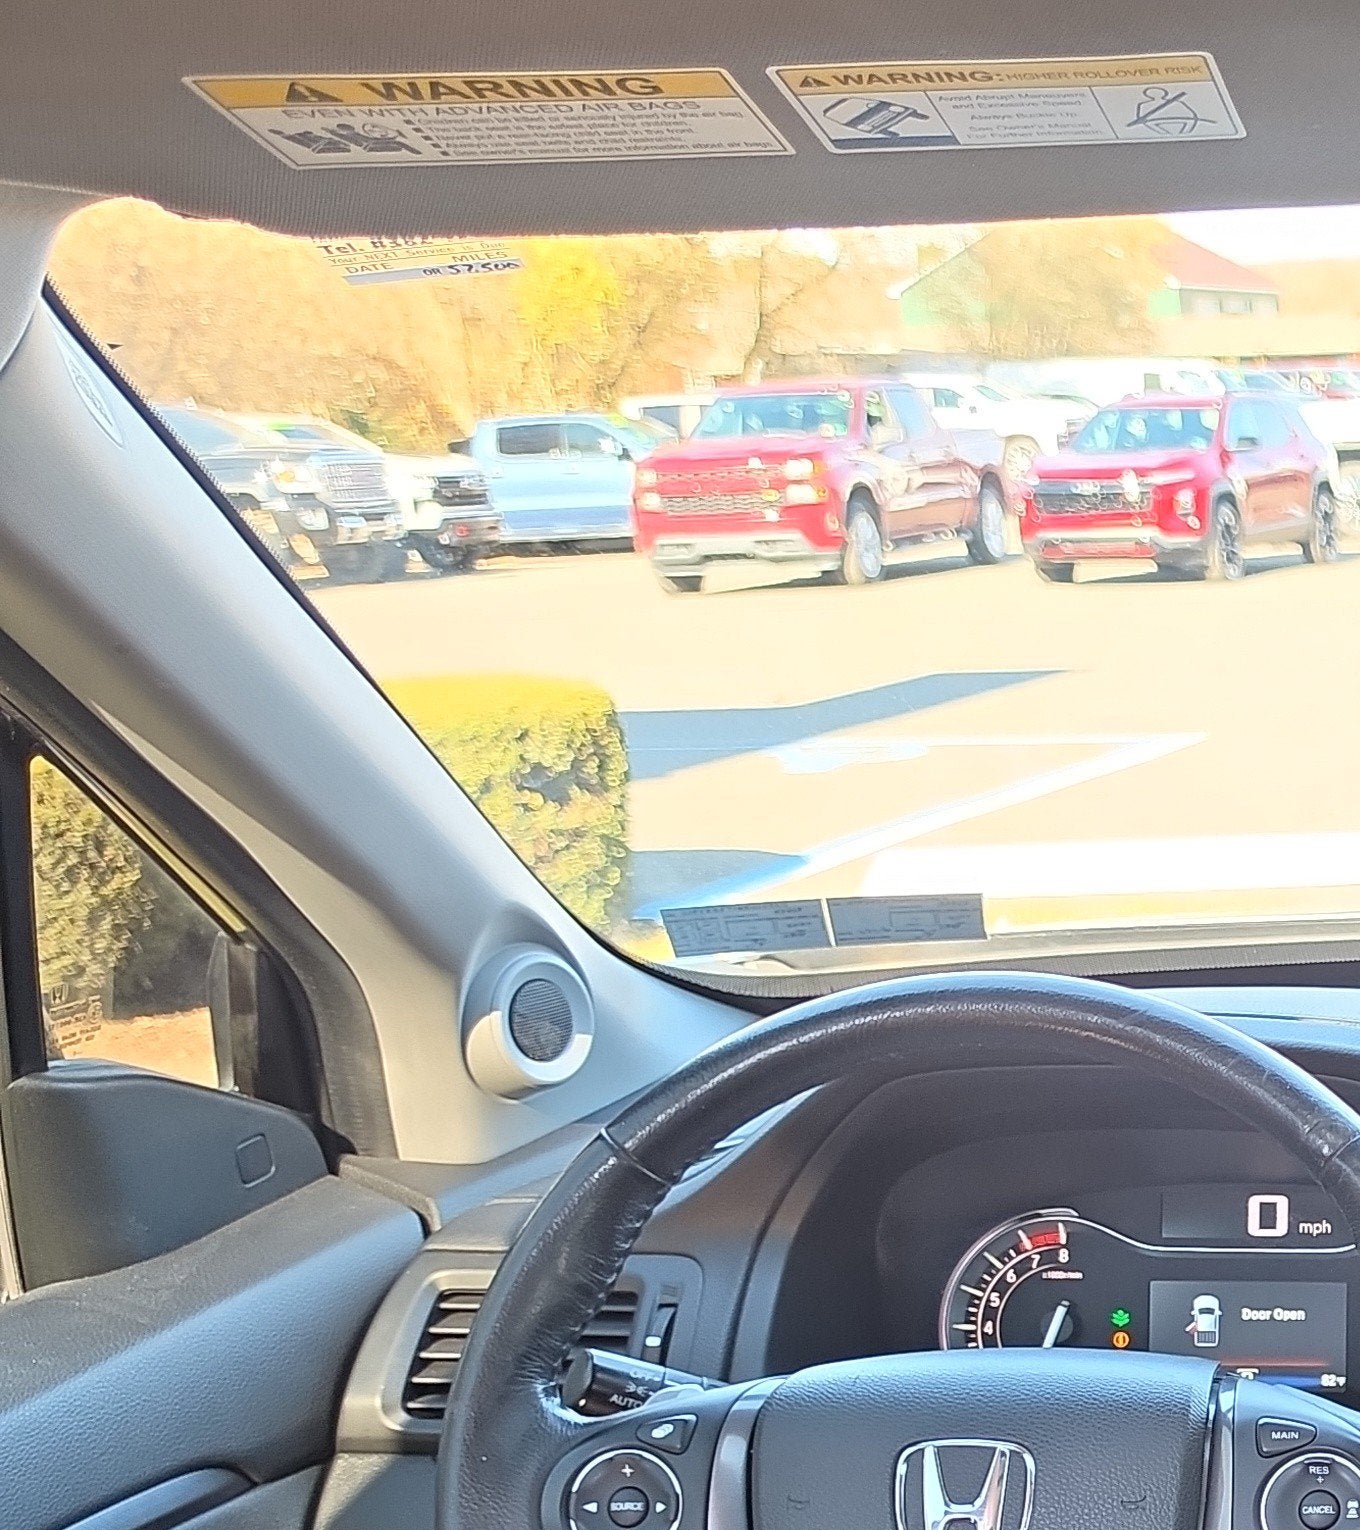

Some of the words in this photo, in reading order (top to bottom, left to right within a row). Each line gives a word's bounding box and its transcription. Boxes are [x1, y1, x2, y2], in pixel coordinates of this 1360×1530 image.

[832, 70, 1004, 86] WARNING:
[1006, 71, 1068, 81] HIGHER
[1070, 68, 1160, 80] ROLLOVER
[1164, 65, 1201, 76] RISK
[361, 77, 664, 101] WARNING
[282, 108, 355, 119] EVEN
[359, 106, 429, 117] WITH
[435, 103, 573, 117] ADVANCED
[581, 101, 625, 113] AIR
[627, 100, 702, 112] BAGS
[345, 262, 395, 274] DATE
[451, 250, 509, 263] MILES
[1247, 1194, 1290, 1238] 0
[1298, 1219, 1332, 1237] mph
[1030, 1254, 1041, 1269] 7
[1058, 1248, 1069, 1263] 8
[1006, 1268, 1017, 1283] 6
[989, 1292, 1000, 1307] 5
[1241, 1307, 1272, 1321] Door
[1273, 1307, 1306, 1322] Open
[983, 1320, 994, 1335] 4
[609, 1393, 643, 1409] AUTO
[1271, 1430, 1299, 1440] MAIN
[1308, 1465, 1330, 1475] RES
[1302, 1505, 1336, 1515] CANCEL
